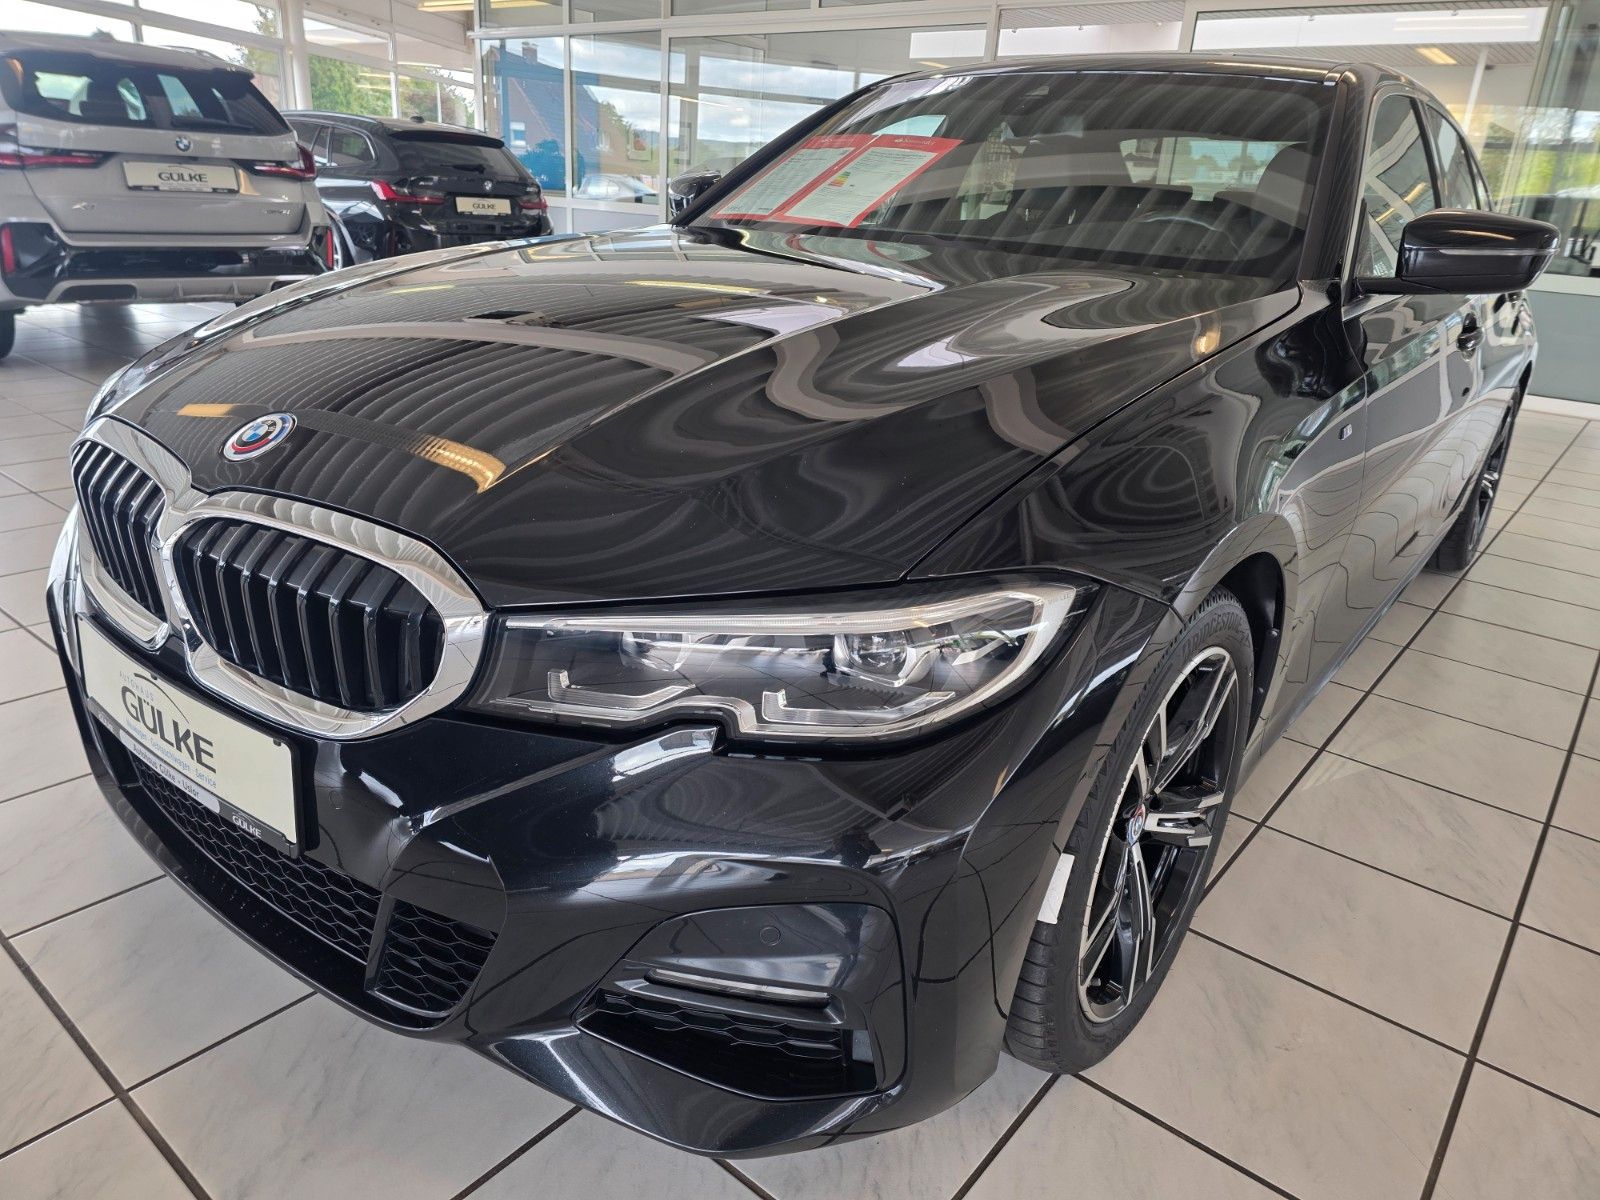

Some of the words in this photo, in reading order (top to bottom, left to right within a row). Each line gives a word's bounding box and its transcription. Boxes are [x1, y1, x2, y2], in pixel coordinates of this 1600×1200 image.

[158, 171, 208, 183] GÜLKE
[121, 685, 217, 774] GÜLKE
[232, 815, 262, 839] GÜLKE
